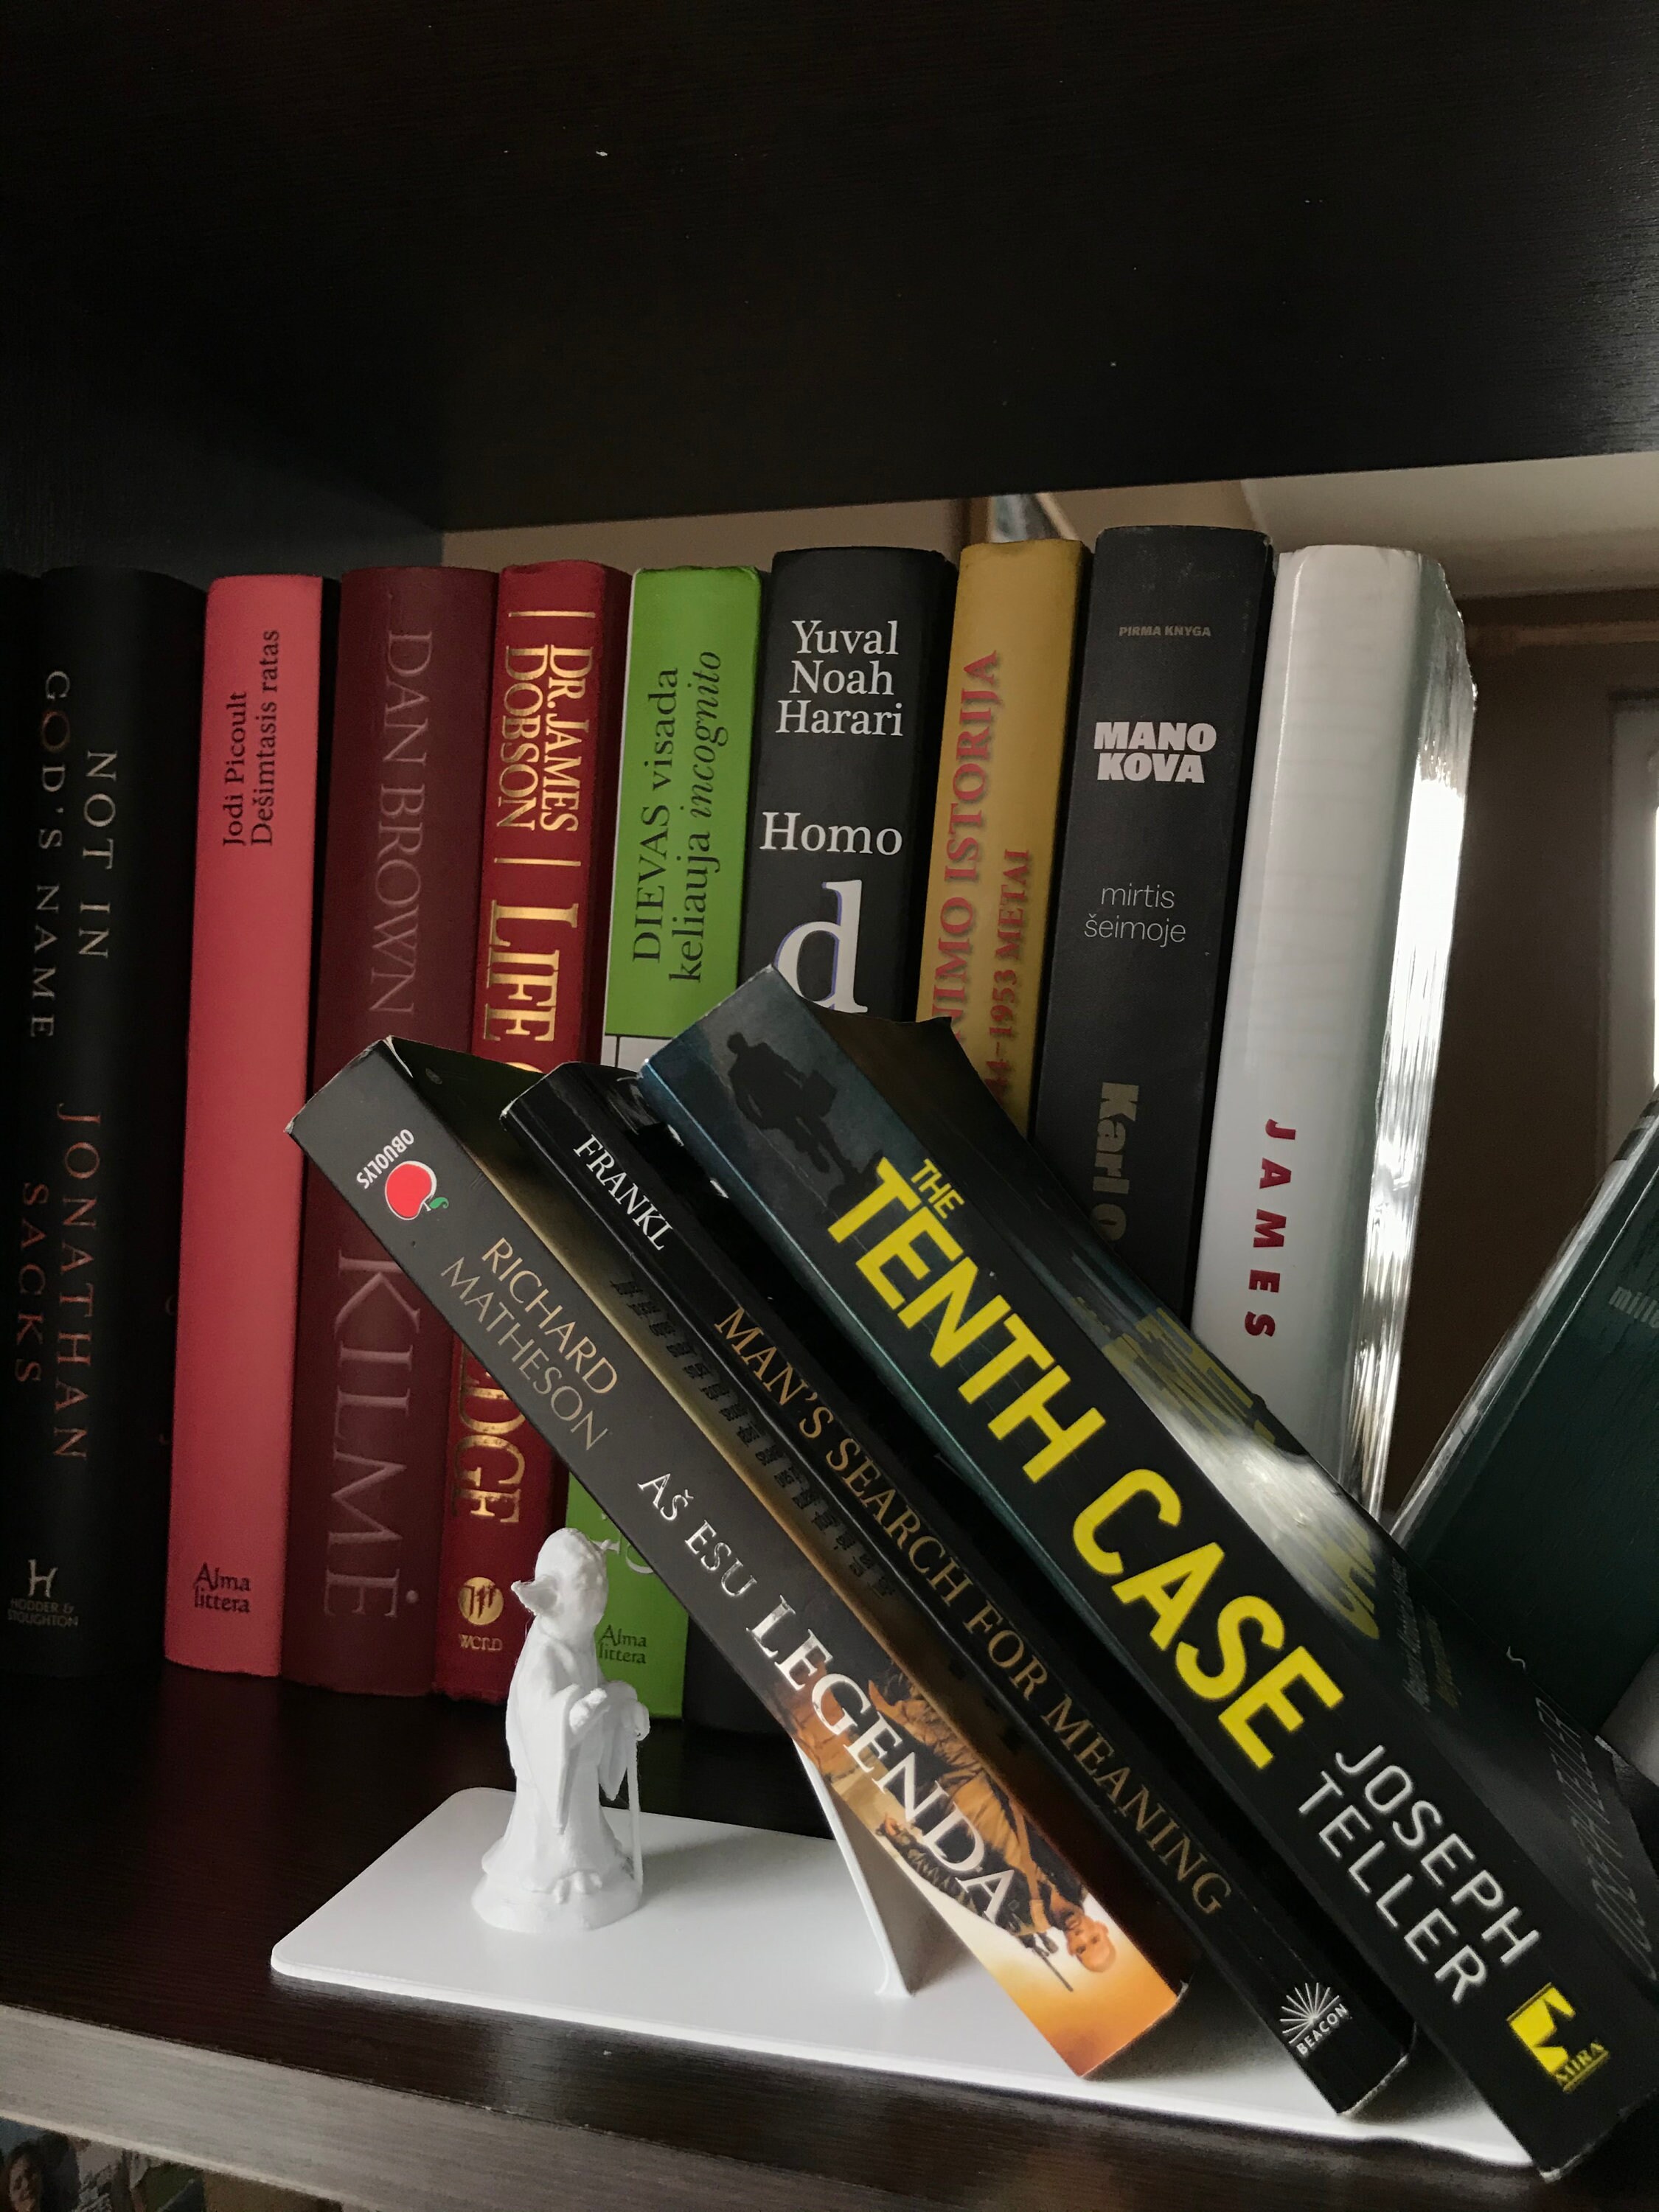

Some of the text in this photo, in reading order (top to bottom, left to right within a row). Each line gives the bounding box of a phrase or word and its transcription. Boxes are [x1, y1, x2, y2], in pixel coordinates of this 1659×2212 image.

[789, 661, 894, 695] Noah
[791, 619, 899, 655] Yuval
[1119, 625, 1211, 638] PIRMA KNYGA
[223, 691, 248, 846] Jodi Picoult
[251, 630, 280, 846] Dešimtasis ratas
[497, 644, 547, 831] DOBSON
[540, 712, 590, 832] JAMES
[775, 700, 903, 737] Harari
[945, 650, 999, 883] ISTORIJA
[1093, 721, 1217, 752] MANO
[1097, 751, 1206, 784] KOVA
[30, 669, 71, 1038] GOD'S NAME
[78, 750, 118, 959] NOT IN
[369, 630, 433, 1015] DAN BROWN
[632, 667, 679, 964] DIEVAS visada
[669, 652, 728, 983] keliauja incognito
[759, 813, 903, 855] Homo
[774, 879, 868, 1013] d
[995, 849, 1031, 959] METAI
[1084, 914, 1186, 948] šeimoje
[1100, 883, 1175, 909] mirtis
[483, 900, 579, 1042] LIFE
[358, 1129, 414, 1189] OBUOLYS
[573, 1134, 673, 1251] FRANKL
[909, 1158, 964, 1220] THE
[1092, 1082, 1140, 1194] Karl
[15, 1183, 49, 1383] SACKS
[52, 1103, 100, 1461] JONATHAN
[1244, 1119, 1296, 1338] JAMES
[440, 1256, 608, 1451] MATHESON
[481, 1237, 617, 1394] RICHARD
[827, 1156, 1106, 1484] TENTH
[1071, 1468, 1344, 1770] CASE
[193, 1563, 251, 1592] Alma
[194, 1586, 251, 1614] littera
[598, 1624, 647, 1647] Alma
[714, 1304, 1232, 1916] MAN'S SEARCH FOR MEANING
[598, 1643, 646, 1664] littera
[637, 1472, 694, 1521] AŠ
[685, 1520, 757, 1598] ESU
[745, 1594, 1015, 1924] LEGENDA
[1298, 1770, 1487, 2005] TELLER
[1335, 1745, 1540, 1966] JOSEPH
[1295, 2003, 1350, 2057] BEACON
